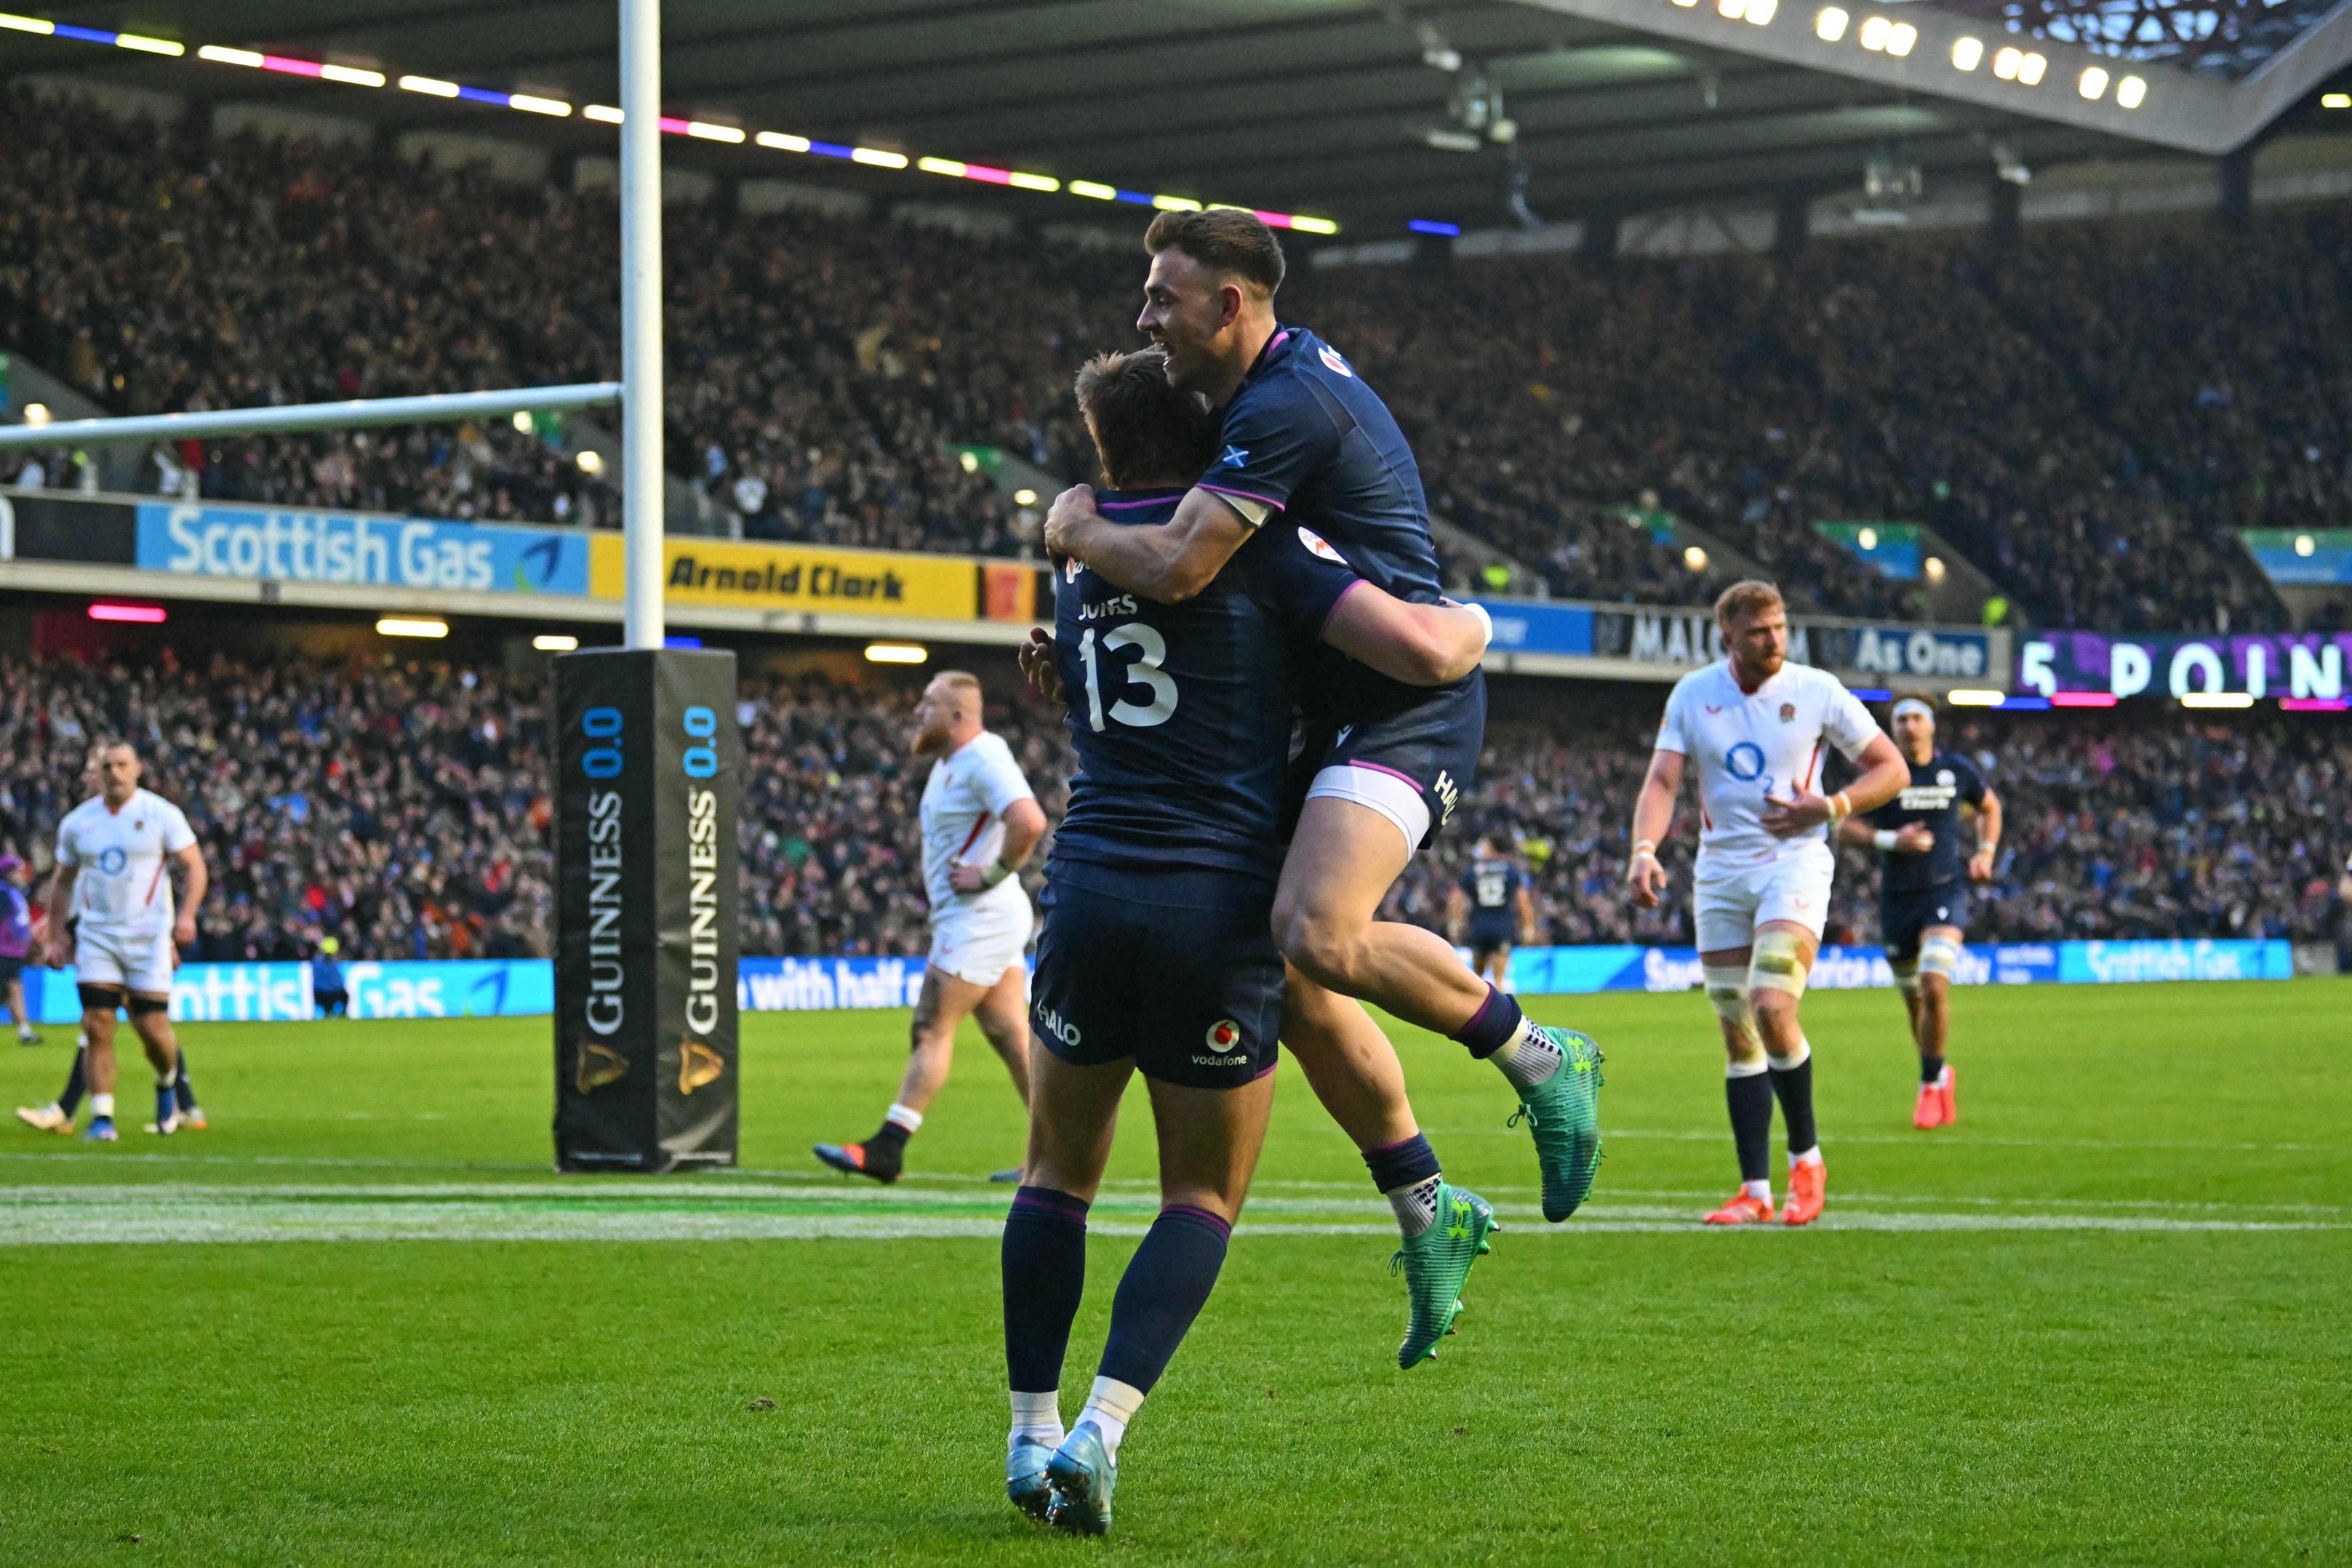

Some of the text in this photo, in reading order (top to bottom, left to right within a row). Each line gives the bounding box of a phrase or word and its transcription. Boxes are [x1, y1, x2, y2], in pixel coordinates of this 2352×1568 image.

[167, 504, 493, 591] Scottish Gas
[668, 555, 909, 602] Arnold Clark
[1078, 622, 1179, 732] 13
[1857, 626, 1901, 673] As
[1907, 630, 1982, 676] One
[2022, 642, 2342, 700] 5 POIN
[582, 707, 624, 1035] GUINNESS 0.0
[683, 706, 718, 1035] GUINNESS 0.0
[347, 961, 445, 1019] Gas
[1037, 999, 1081, 1047] HALO
[1192, 1053, 1248, 1067] vodafone
